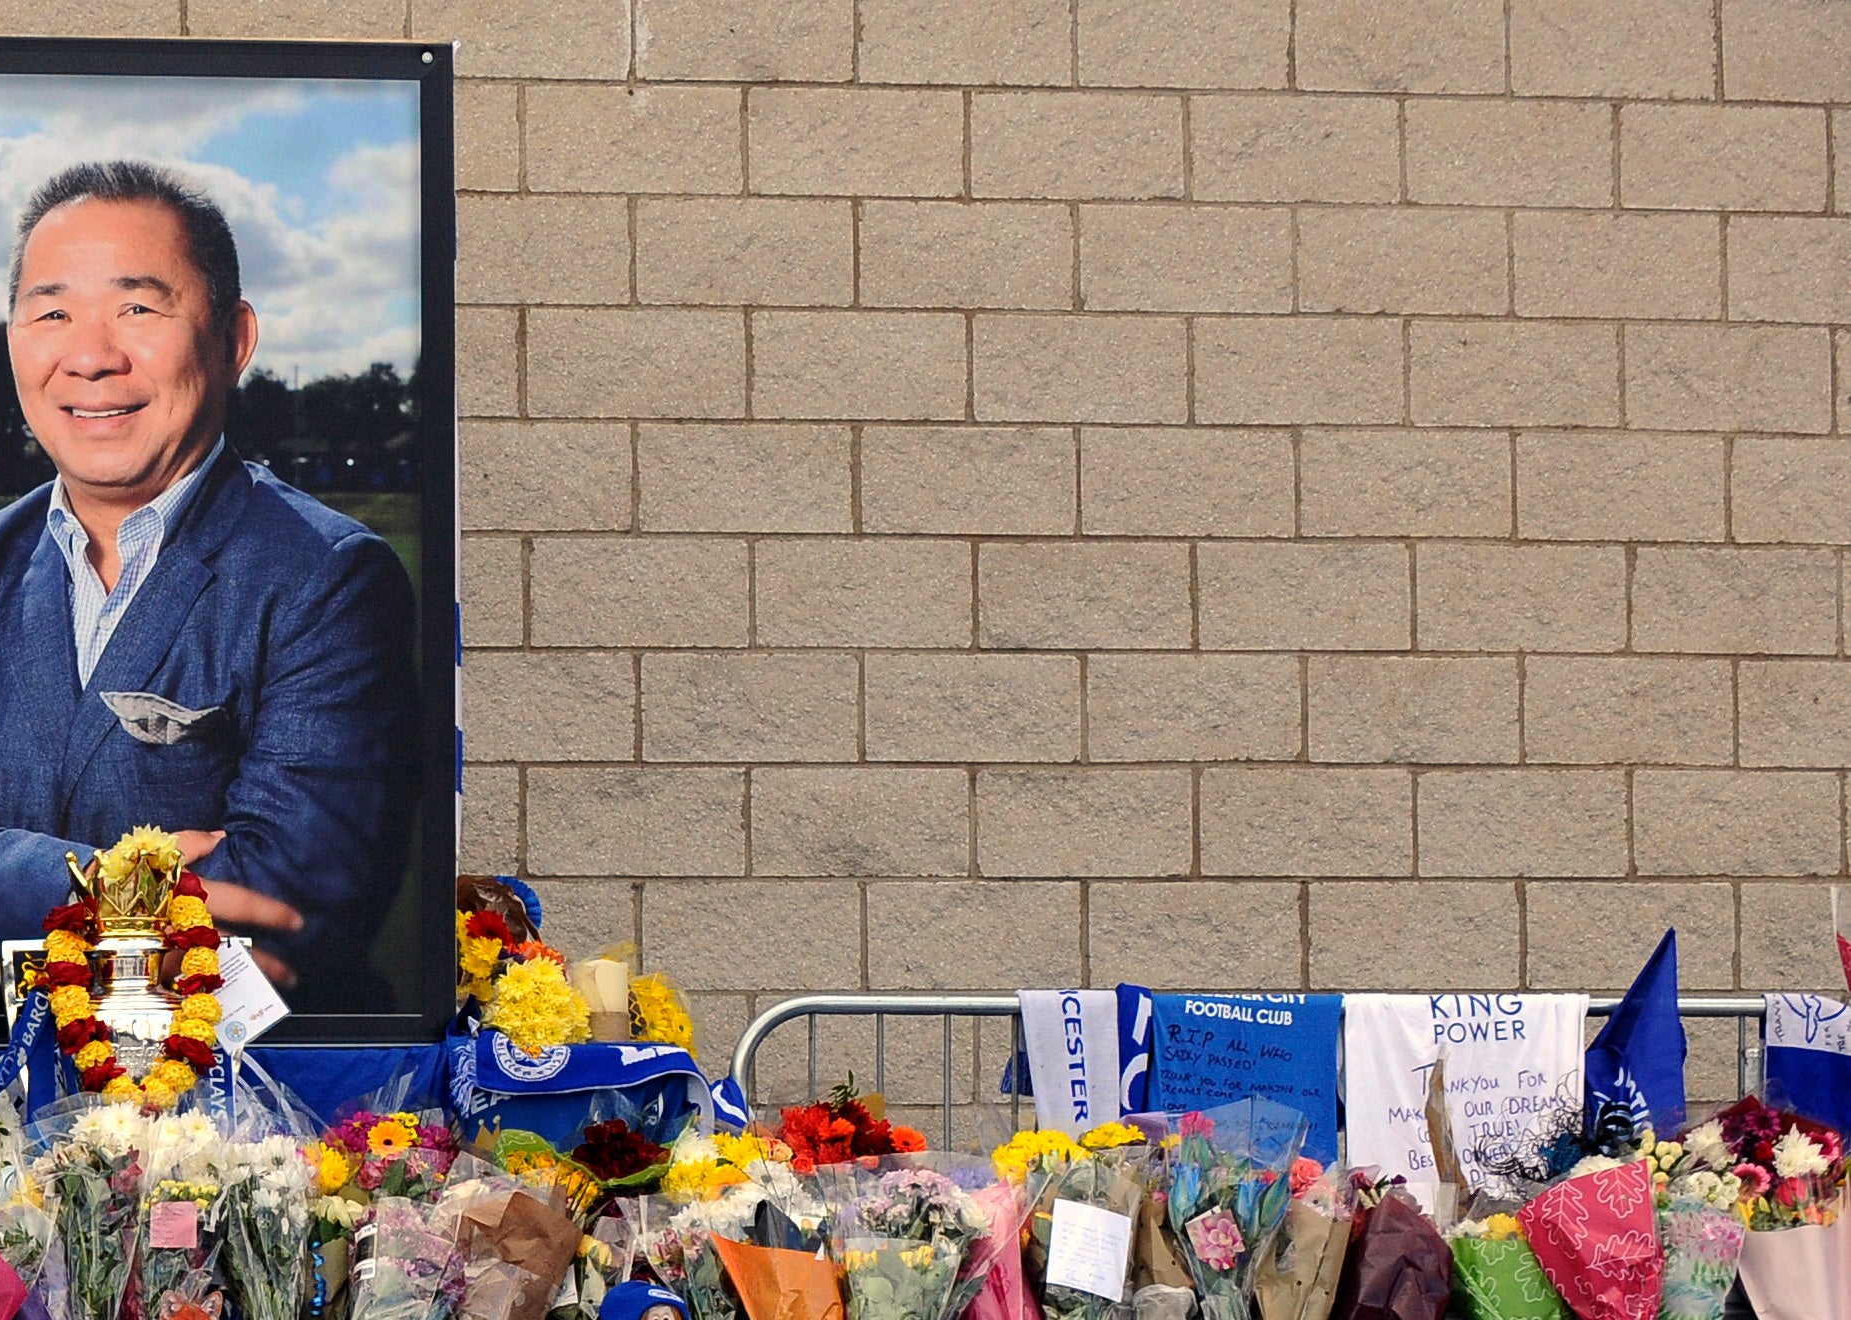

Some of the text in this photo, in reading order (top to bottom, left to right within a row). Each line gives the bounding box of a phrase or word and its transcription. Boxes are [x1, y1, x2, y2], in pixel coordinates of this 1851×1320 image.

[1185, 998, 1294, 1026] FOOTBALL CLUB
[1430, 994, 1523, 1020] KING
[1433, 1019, 1527, 1044] POWER
[1058, 989, 1090, 1123] ICESTER
[1226, 1039, 1250, 1054] ALL
[1517, 1068, 1547, 1091] FOR
[1464, 1100, 1494, 1119] OUR
